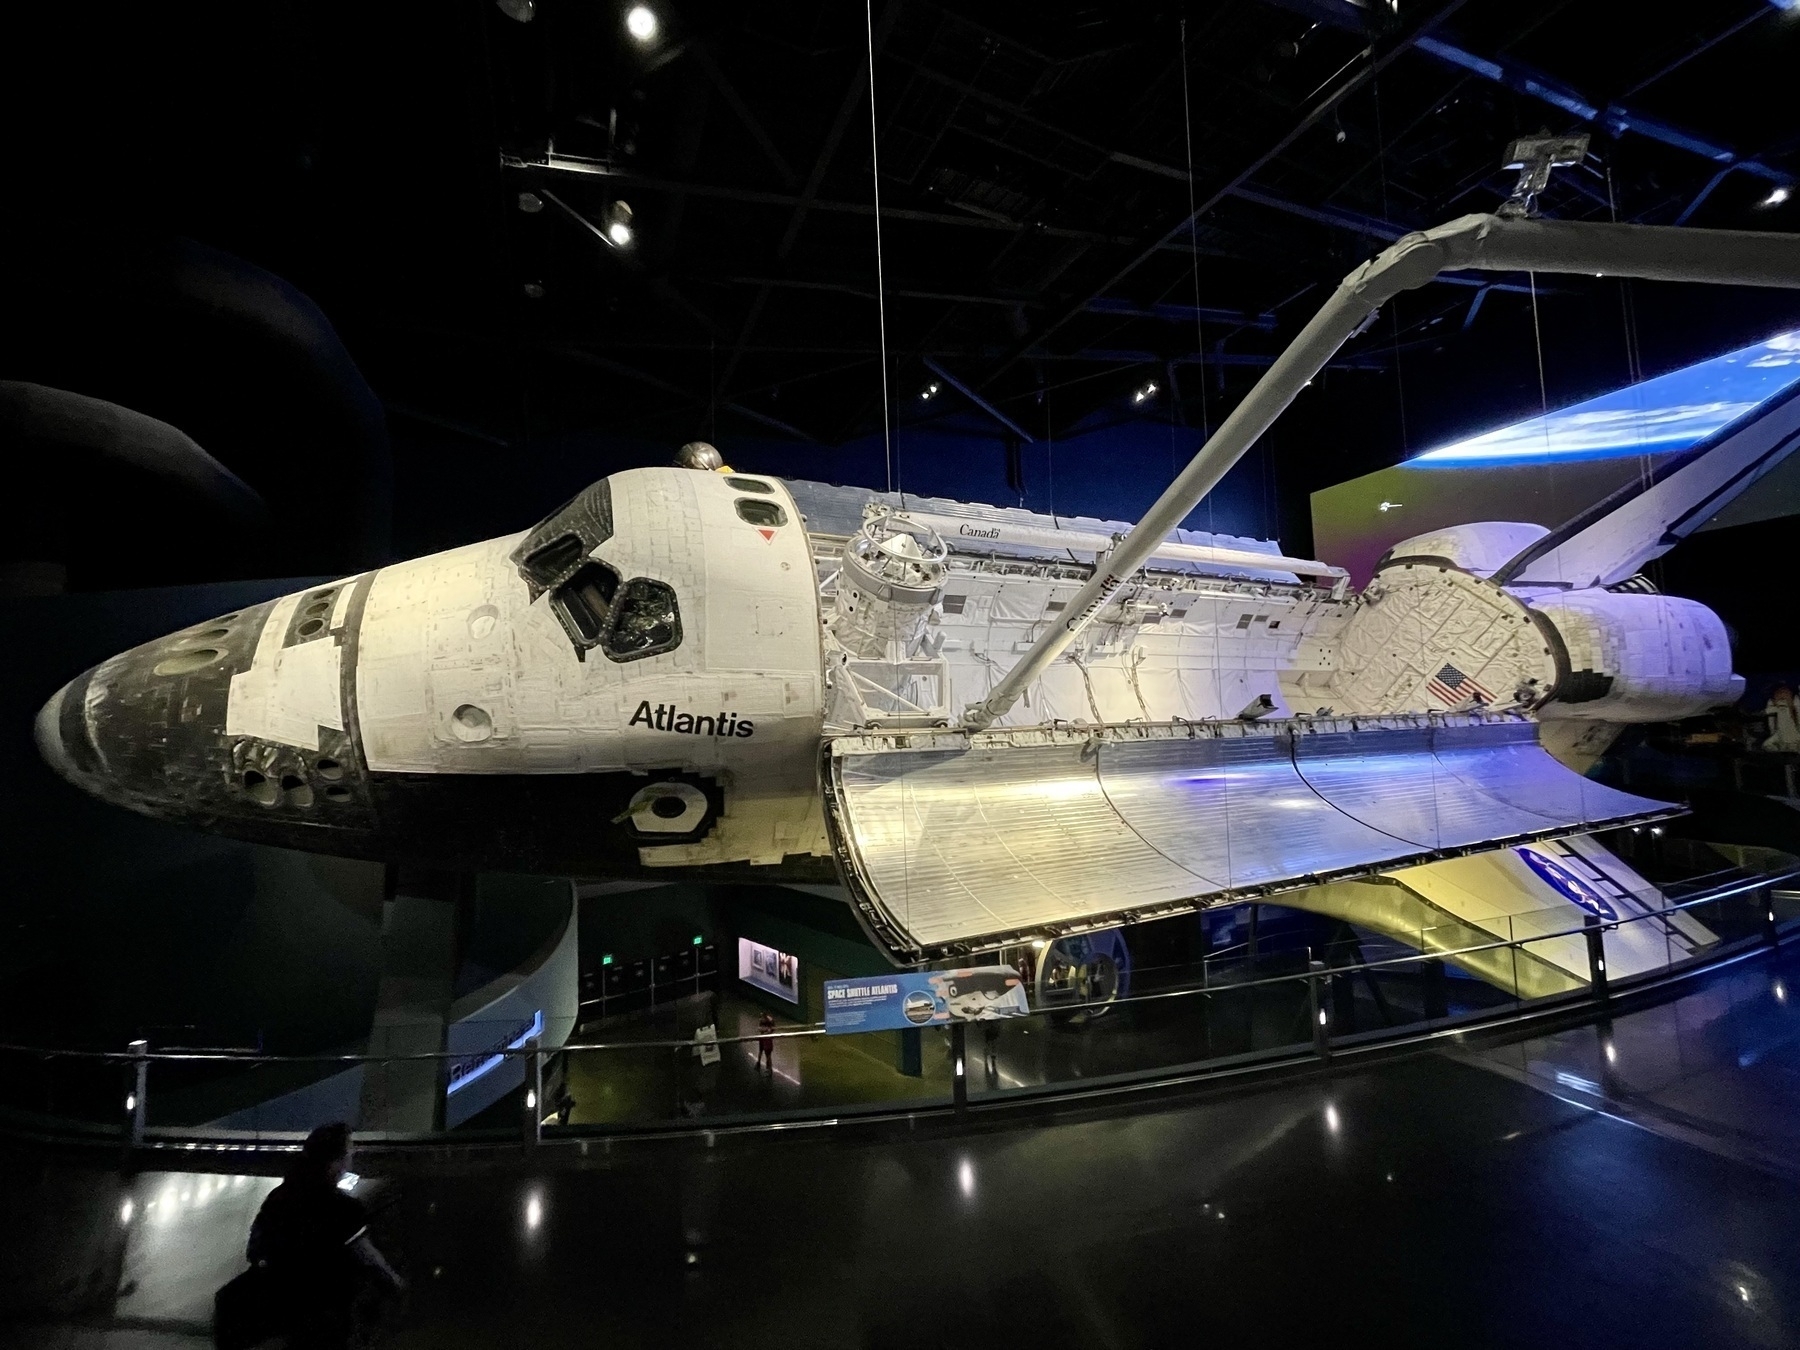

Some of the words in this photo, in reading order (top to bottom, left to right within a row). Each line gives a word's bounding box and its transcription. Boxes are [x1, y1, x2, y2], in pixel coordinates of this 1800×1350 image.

[959, 523, 1000, 539] Canada
[628, 700, 754, 738] Atlantis
[827, 989, 846, 1000] SPACE
[846, 986, 871, 998] SHUTTLE
[871, 984, 898, 995] ATLANTIS
